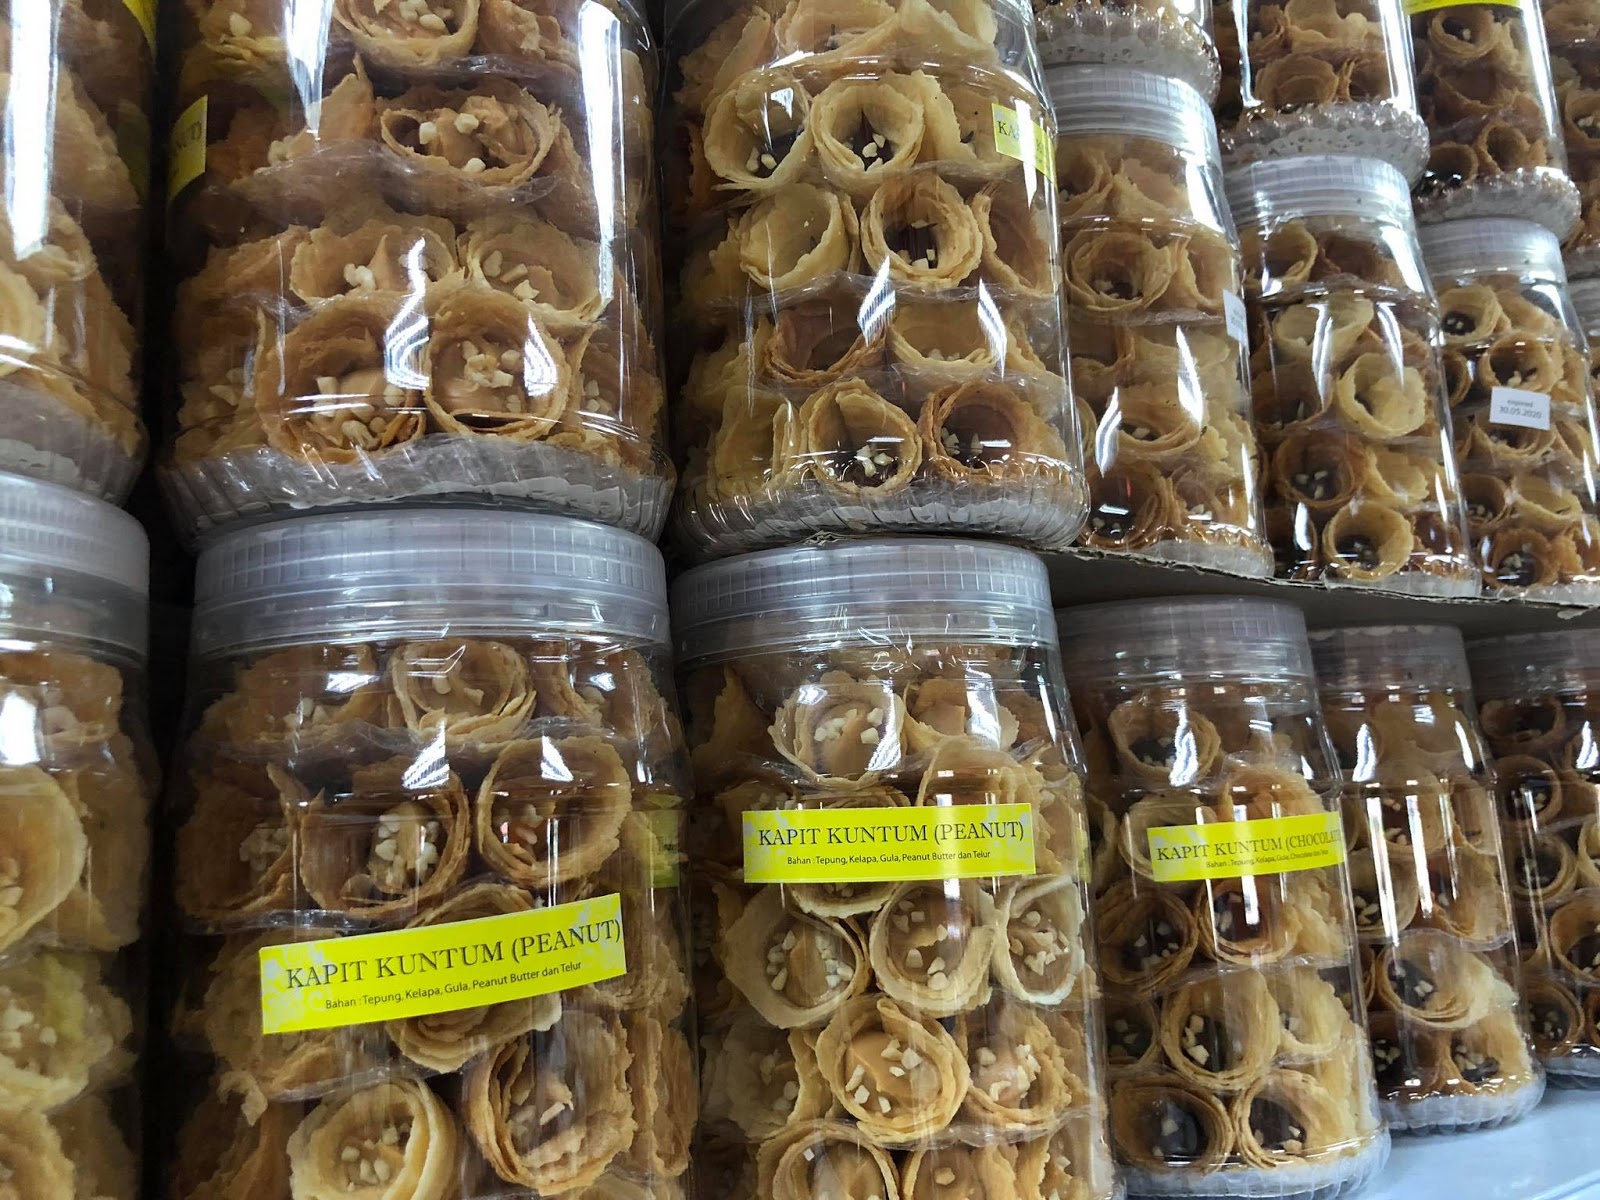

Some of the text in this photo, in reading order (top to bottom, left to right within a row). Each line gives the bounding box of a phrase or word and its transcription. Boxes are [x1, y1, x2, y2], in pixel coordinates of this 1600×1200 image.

[758, 821, 1024, 846] KAPIT KUNTUM (PEANUT)
[787, 856, 811, 865] Bahan
[849, 854, 879, 864] Kelapa,
[880, 853, 901, 863] Gula,
[902, 852, 930, 862] Peanut
[932, 851, 956, 861] Butter
[957, 850, 972, 860] dan
[973, 849, 991, 859] Telur
[1156, 844, 1209, 861] KAPIT
[1214, 837, 1282, 856] KUNTUM
[285, 918, 621, 989] KAPIT KUNTUM (PEANUT)
[325, 998, 356, 1010] Bahan
[405, 987, 443, 998] Kelapa,
[444, 981, 471, 994] Gula,
[472, 976, 508, 990] Peanut
[510, 970, 540, 983] Butter
[541, 966, 560, 977] dan
[561, 961, 582, 973] Telur
